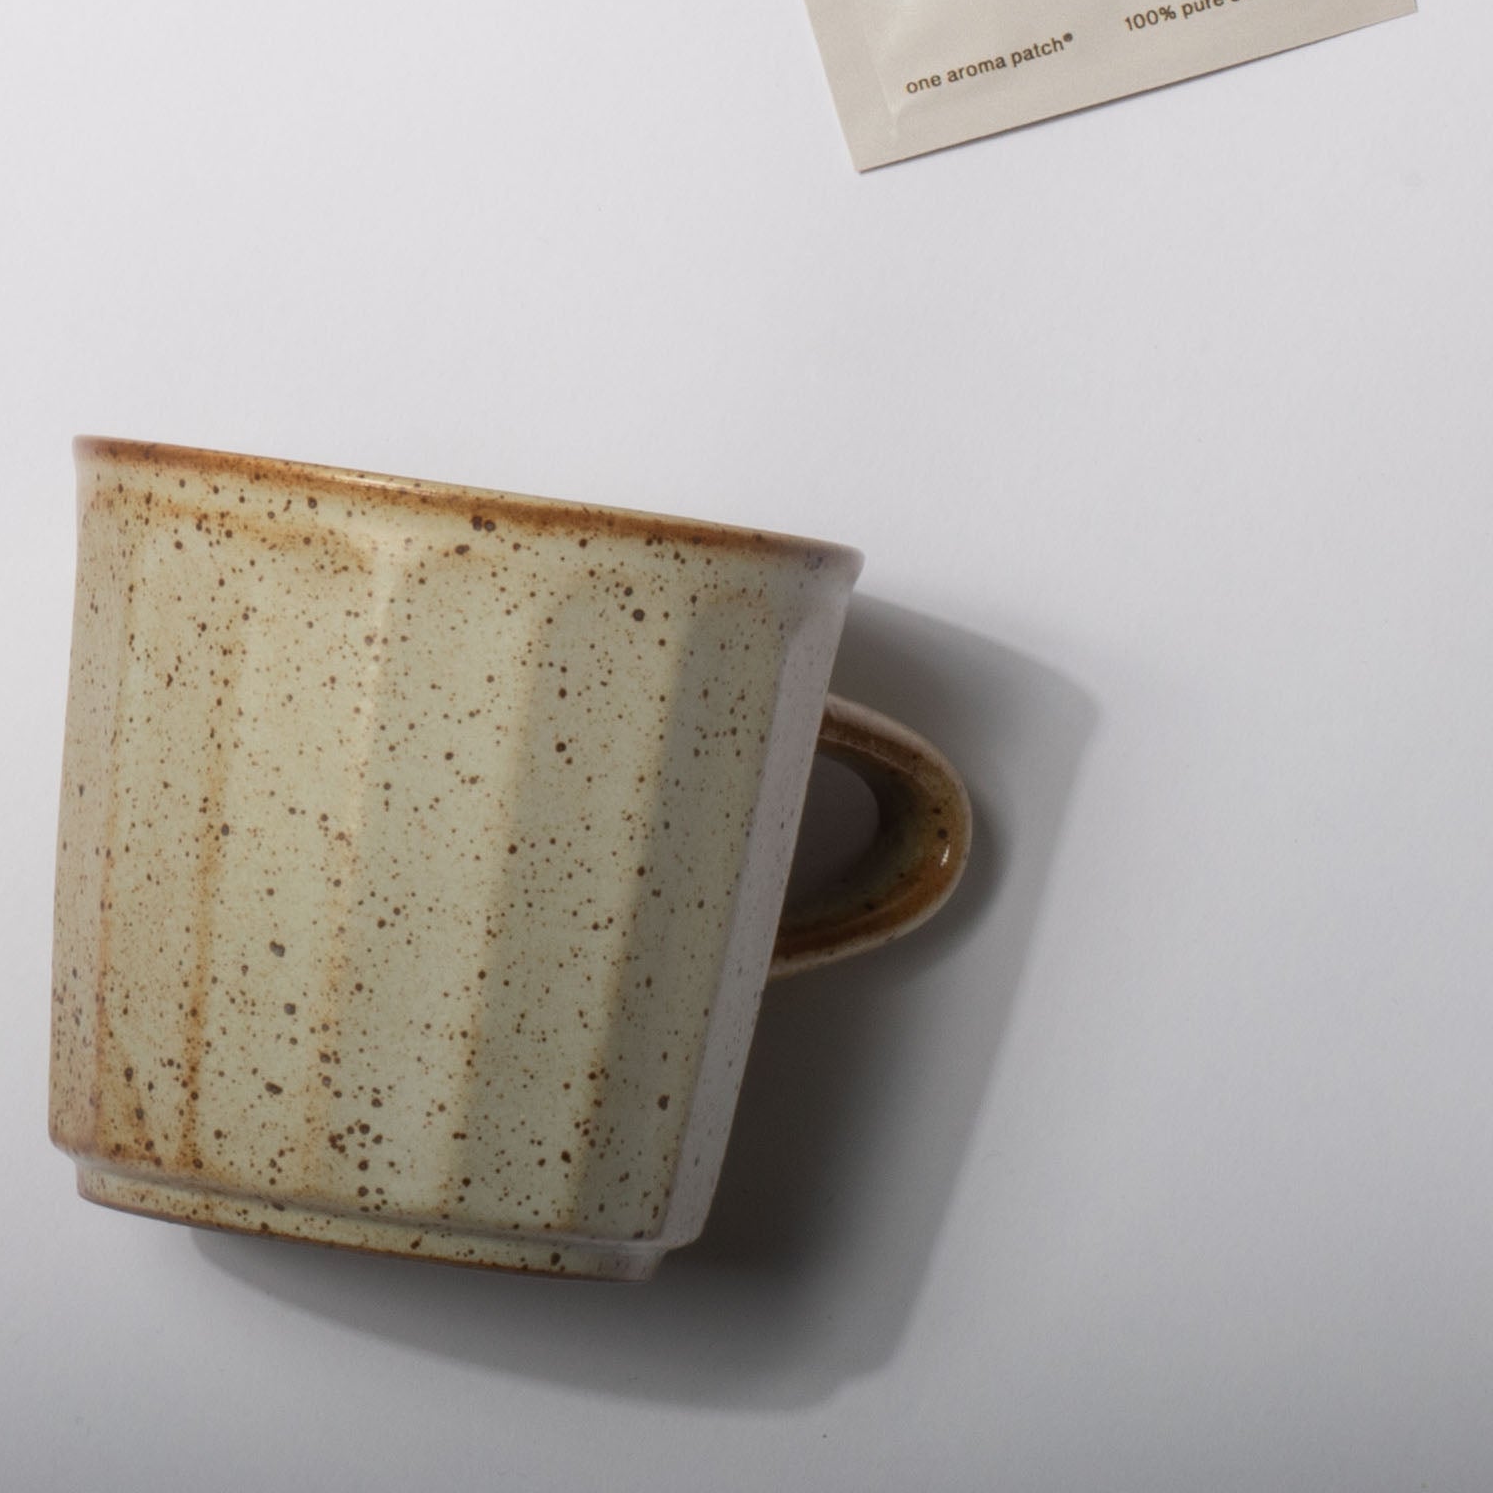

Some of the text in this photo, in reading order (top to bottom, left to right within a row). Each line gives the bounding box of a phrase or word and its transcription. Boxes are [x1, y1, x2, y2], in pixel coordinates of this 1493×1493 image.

[1124, 4, 1178, 32] 100%
[905, 74, 943, 95] one
[946, 55, 1008, 84] aroma
